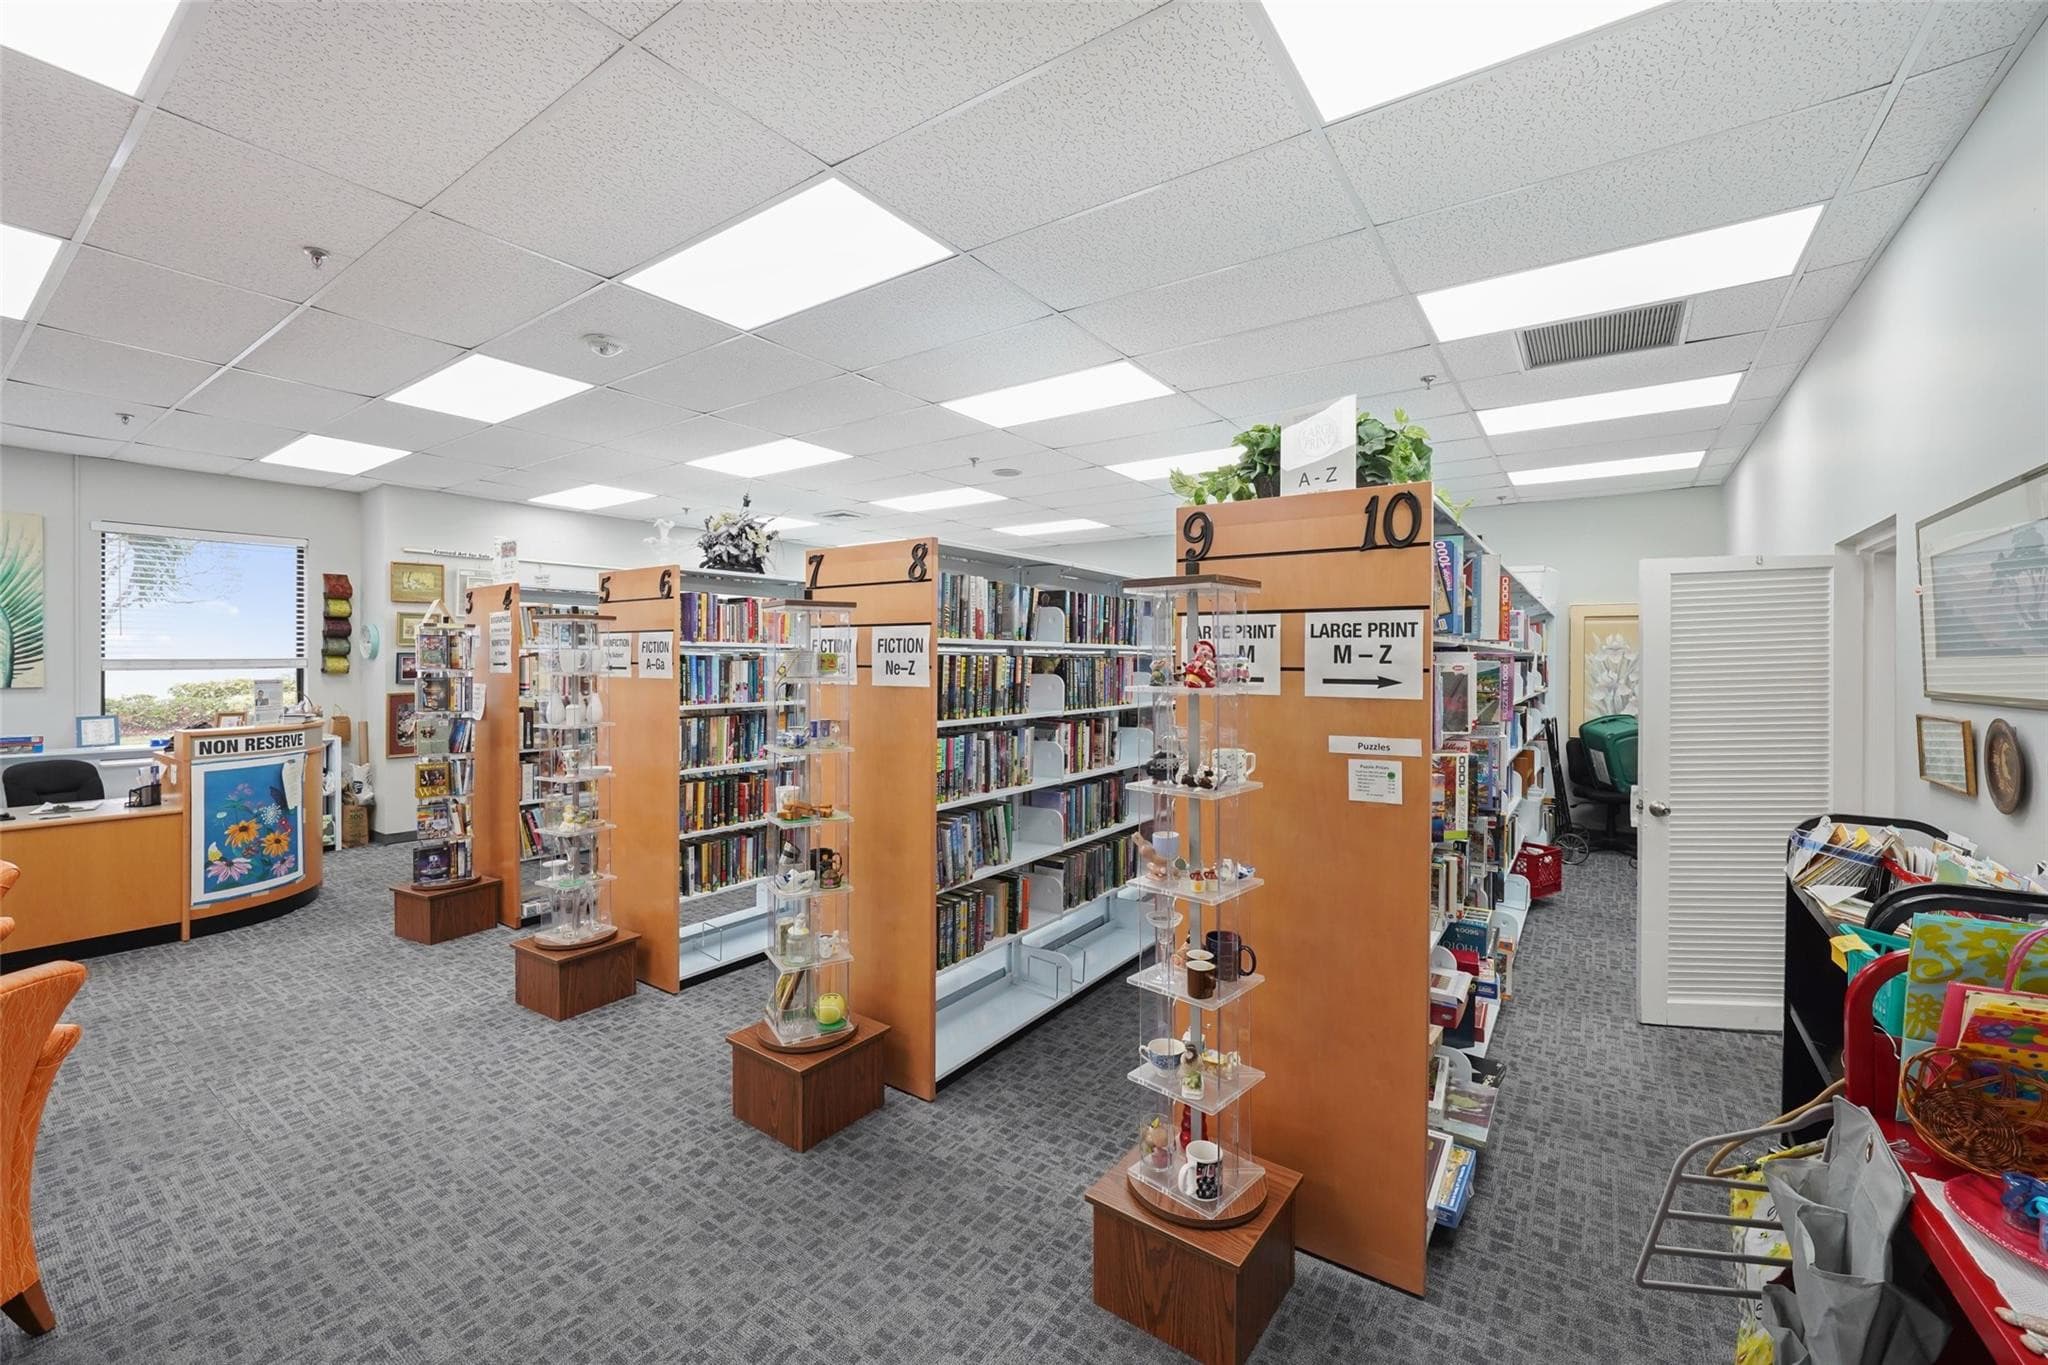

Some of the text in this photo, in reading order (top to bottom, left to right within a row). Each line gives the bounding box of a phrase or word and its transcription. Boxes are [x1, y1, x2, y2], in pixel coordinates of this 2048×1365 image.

[1298, 472, 1311, 488] A
[1325, 466, 1338, 483] Z
[1360, 490, 1423, 552] 10
[1183, 511, 1214, 562] 9
[808, 554, 825, 588] 7
[907, 542, 929, 582] 8
[600, 575, 612, 603] 5
[659, 569, 673, 599] 6
[1501, 577, 1510, 605] 1000
[465, 591, 473, 615] 3
[1186, 624, 1277, 640] ARGE PRINT
[1310, 622, 1419, 639] LARGE PRINT
[641, 641, 670, 653] FICTION
[812, 639, 852, 653] FCTION
[877, 638, 924, 654] FICTION
[1333, 645, 1352, 664] M
[1379, 645, 1393, 664] Z
[199, 733, 304, 756] NON RESERVE
[1357, 742, 1392, 752] Puzzles
[1458, 756, 1466, 789] 1000
